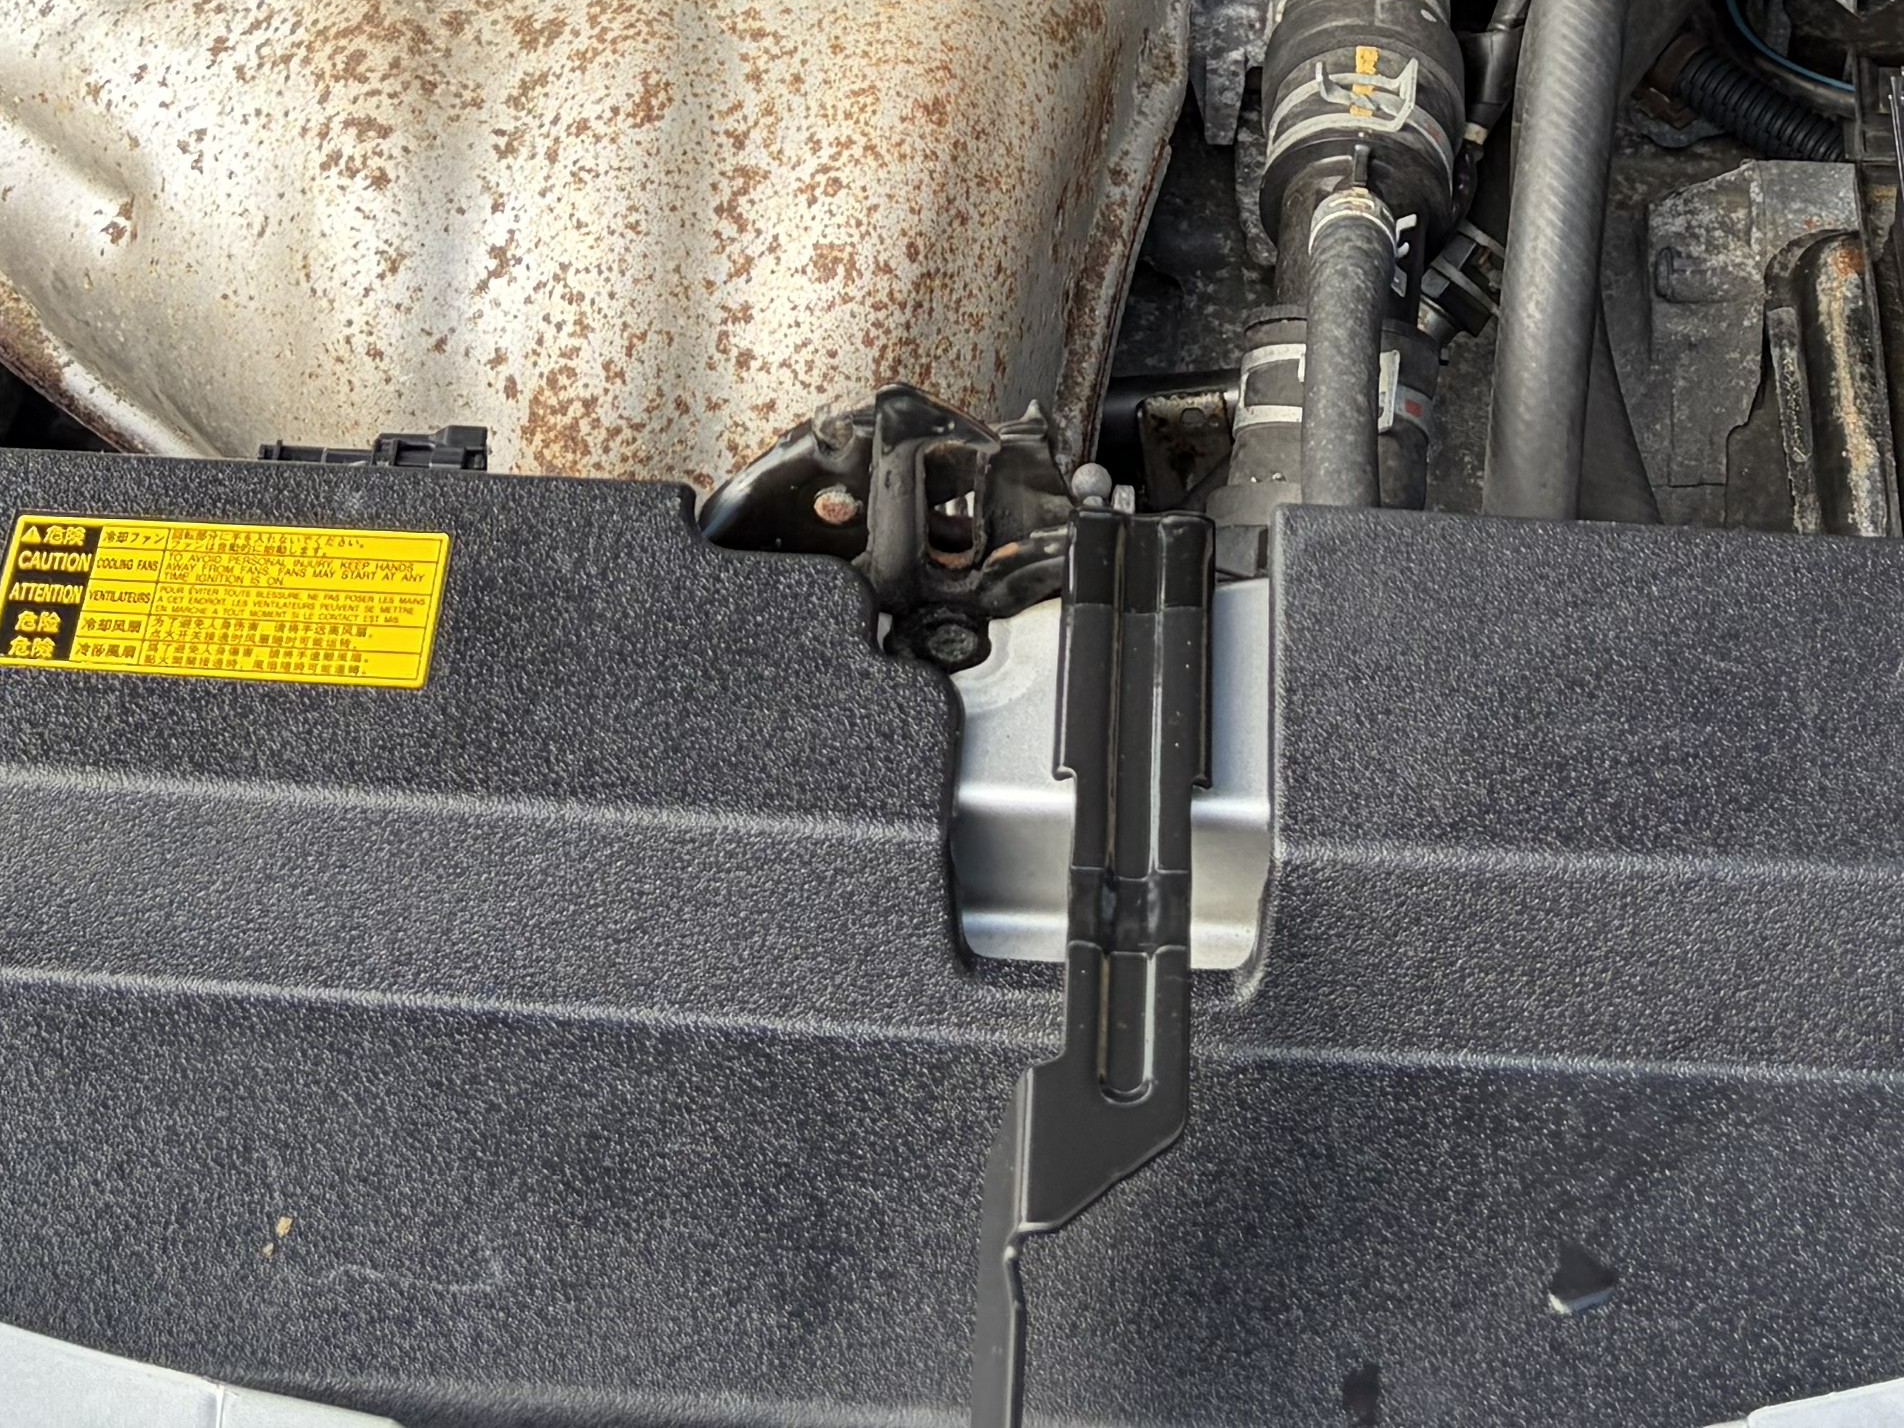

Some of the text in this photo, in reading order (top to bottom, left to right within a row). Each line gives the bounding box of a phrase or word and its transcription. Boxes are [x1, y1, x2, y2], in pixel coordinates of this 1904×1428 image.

[18, 551, 92, 572] CAUTION
[97, 557, 159, 571] COOLING FANS
[170, 552, 414, 572] TO AVOID PERSONAL KEEP HANDS
[166, 563, 196, 572] AWAY
[202, 565, 234, 574] FROM
[312, 570, 335, 578] MAY
[341, 571, 376, 581] START
[382, 573, 395, 581] AT
[401, 573, 424, 583] ANY
[196, 574, 244, 584] IGNITION
[8, 582, 83, 604] ATTENTION
[88, 589, 151, 604] VENTILATEURS
[14, 611, 61, 633] 危险
